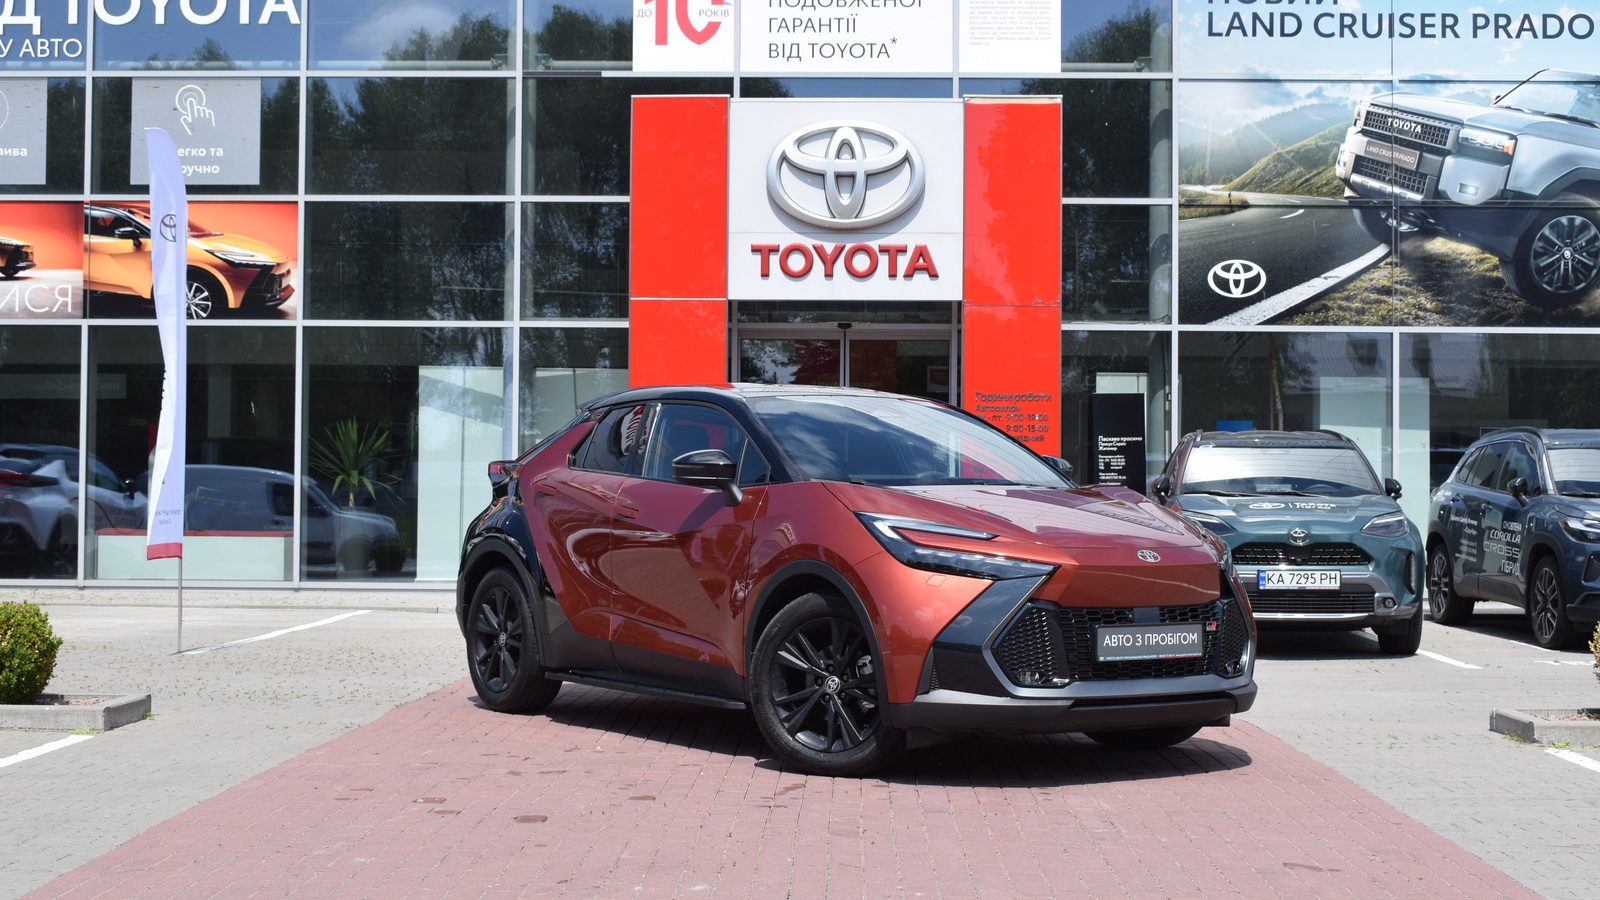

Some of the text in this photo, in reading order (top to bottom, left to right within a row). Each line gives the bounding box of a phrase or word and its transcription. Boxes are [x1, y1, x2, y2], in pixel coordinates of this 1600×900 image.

[637, 9, 652, 18] ДО
[699, 9, 729, 17] РОКІВ
[769, 14, 858, 33] ГАРАНТІЇ
[1208, 11, 1595, 39] LAND CRUISER PRADO
[19, 38, 83, 58] АВТО
[769, 43, 801, 62] ВІД
[1387, 118, 1422, 134] TOYOTA
[177, 148, 223, 157] егко та
[1366, 145, 1379, 153] LAND
[1399, 153, 1415, 163] PRADO
[750, 242, 940, 279] TOYOTA
[975, 392, 1052, 404] Години роботи
[975, 404, 1021, 412] Автосалон
[1006, 424, 1048, 432] 9:00-15:00
[1489, 529, 1521, 544] COROLLA
[1483, 541, 1521, 558] CROSS
[1267, 573, 1337, 585] KA 7295 PH
[1103, 634, 1133, 647] АВТО
[1145, 632, 1198, 646] ПРОБІГОМ
